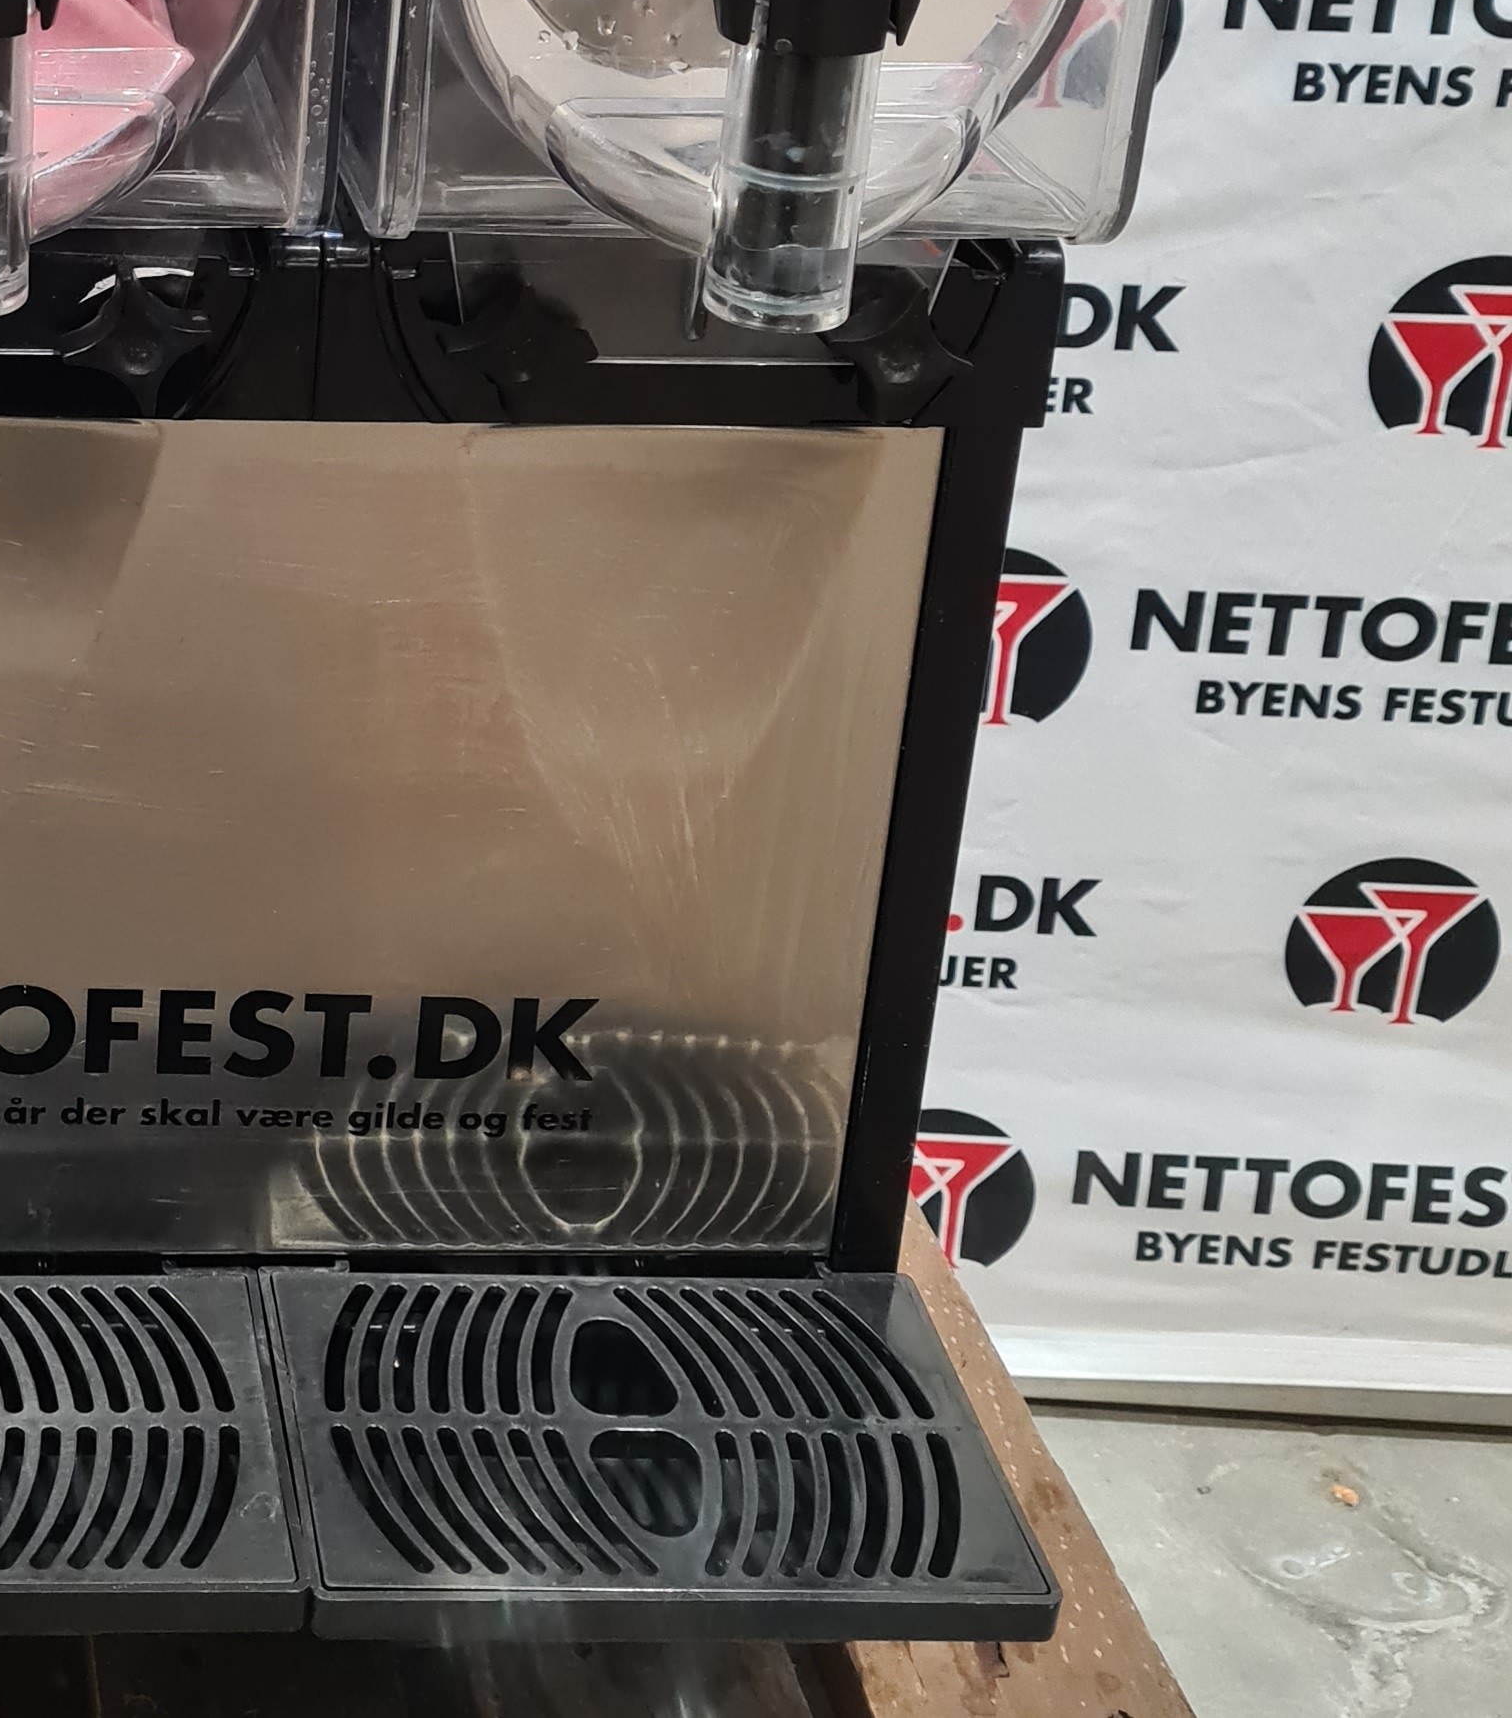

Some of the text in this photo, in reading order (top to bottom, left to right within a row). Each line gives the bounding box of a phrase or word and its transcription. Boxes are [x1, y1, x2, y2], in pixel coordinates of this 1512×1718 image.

[1292, 62, 1476, 107] BYENS
[1195, 680, 1364, 720] BYENS
[59, 1096, 126, 1127] der
[140, 1097, 221, 1128] skal
[236, 1107, 334, 1129] være
[348, 1100, 445, 1136] gilde
[458, 1110, 508, 1138] og
[522, 1102, 593, 1132] fest
[1135, 1231, 1294, 1269] BYENS
